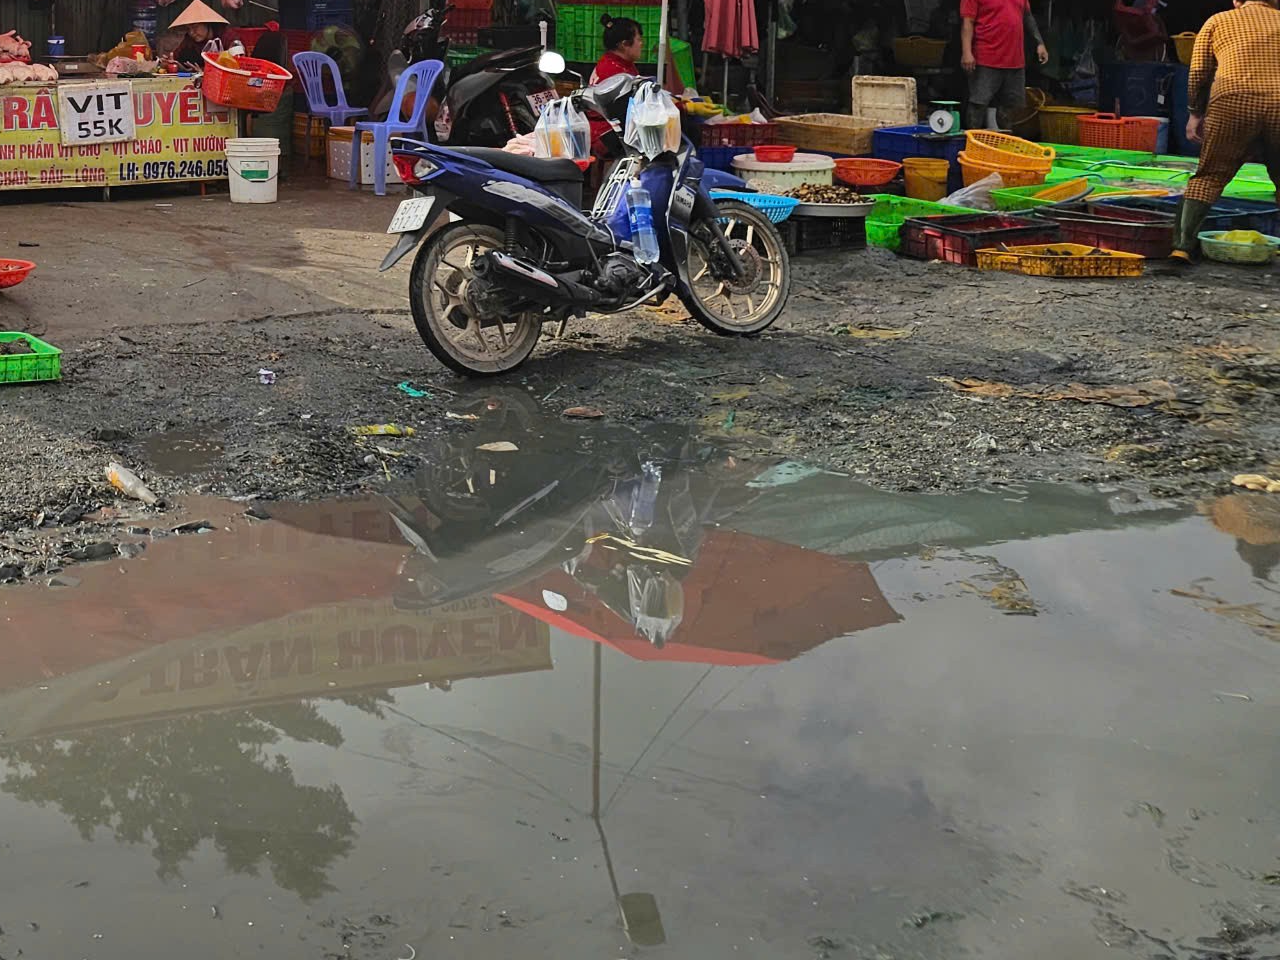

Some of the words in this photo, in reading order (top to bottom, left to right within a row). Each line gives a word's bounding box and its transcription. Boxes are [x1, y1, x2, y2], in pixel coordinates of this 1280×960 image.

[67, 91, 128, 115] VỊT
[77, 118, 125, 139] 55K
[20, 137, 54, 159] PHẨM
[132, 136, 162, 155] CHÁO
[173, 138, 189, 156] VỊT
